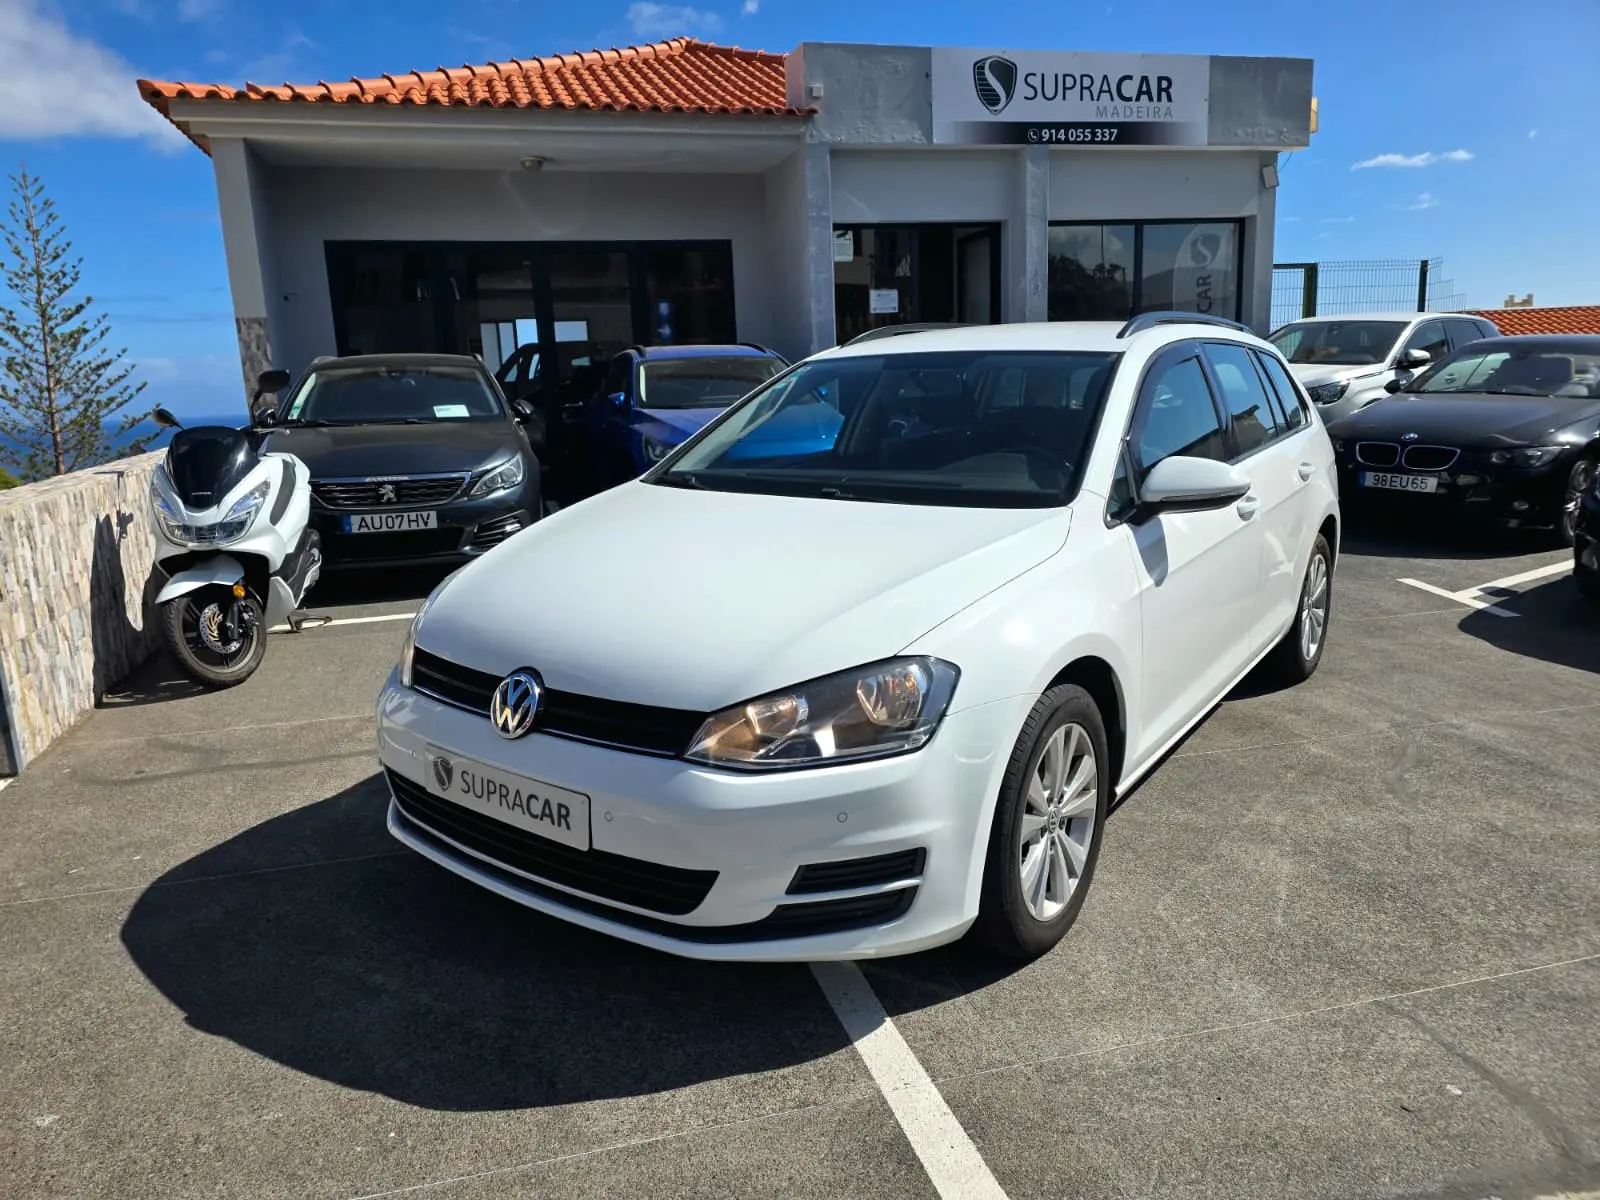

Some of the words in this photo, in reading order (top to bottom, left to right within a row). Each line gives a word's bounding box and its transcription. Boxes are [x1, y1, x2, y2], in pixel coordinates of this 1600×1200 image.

[1023, 72, 1174, 103] SUPRACAR
[1095, 105, 1173, 119] MADEIRA
[1041, 128, 1066, 142] 914
[1068, 128, 1092, 142] 055
[1094, 128, 1118, 142] 337
[1372, 474, 1428, 490] 98EU65
[357, 512, 431, 532] AU07HV
[460, 770, 571, 831] SUPRACAR
